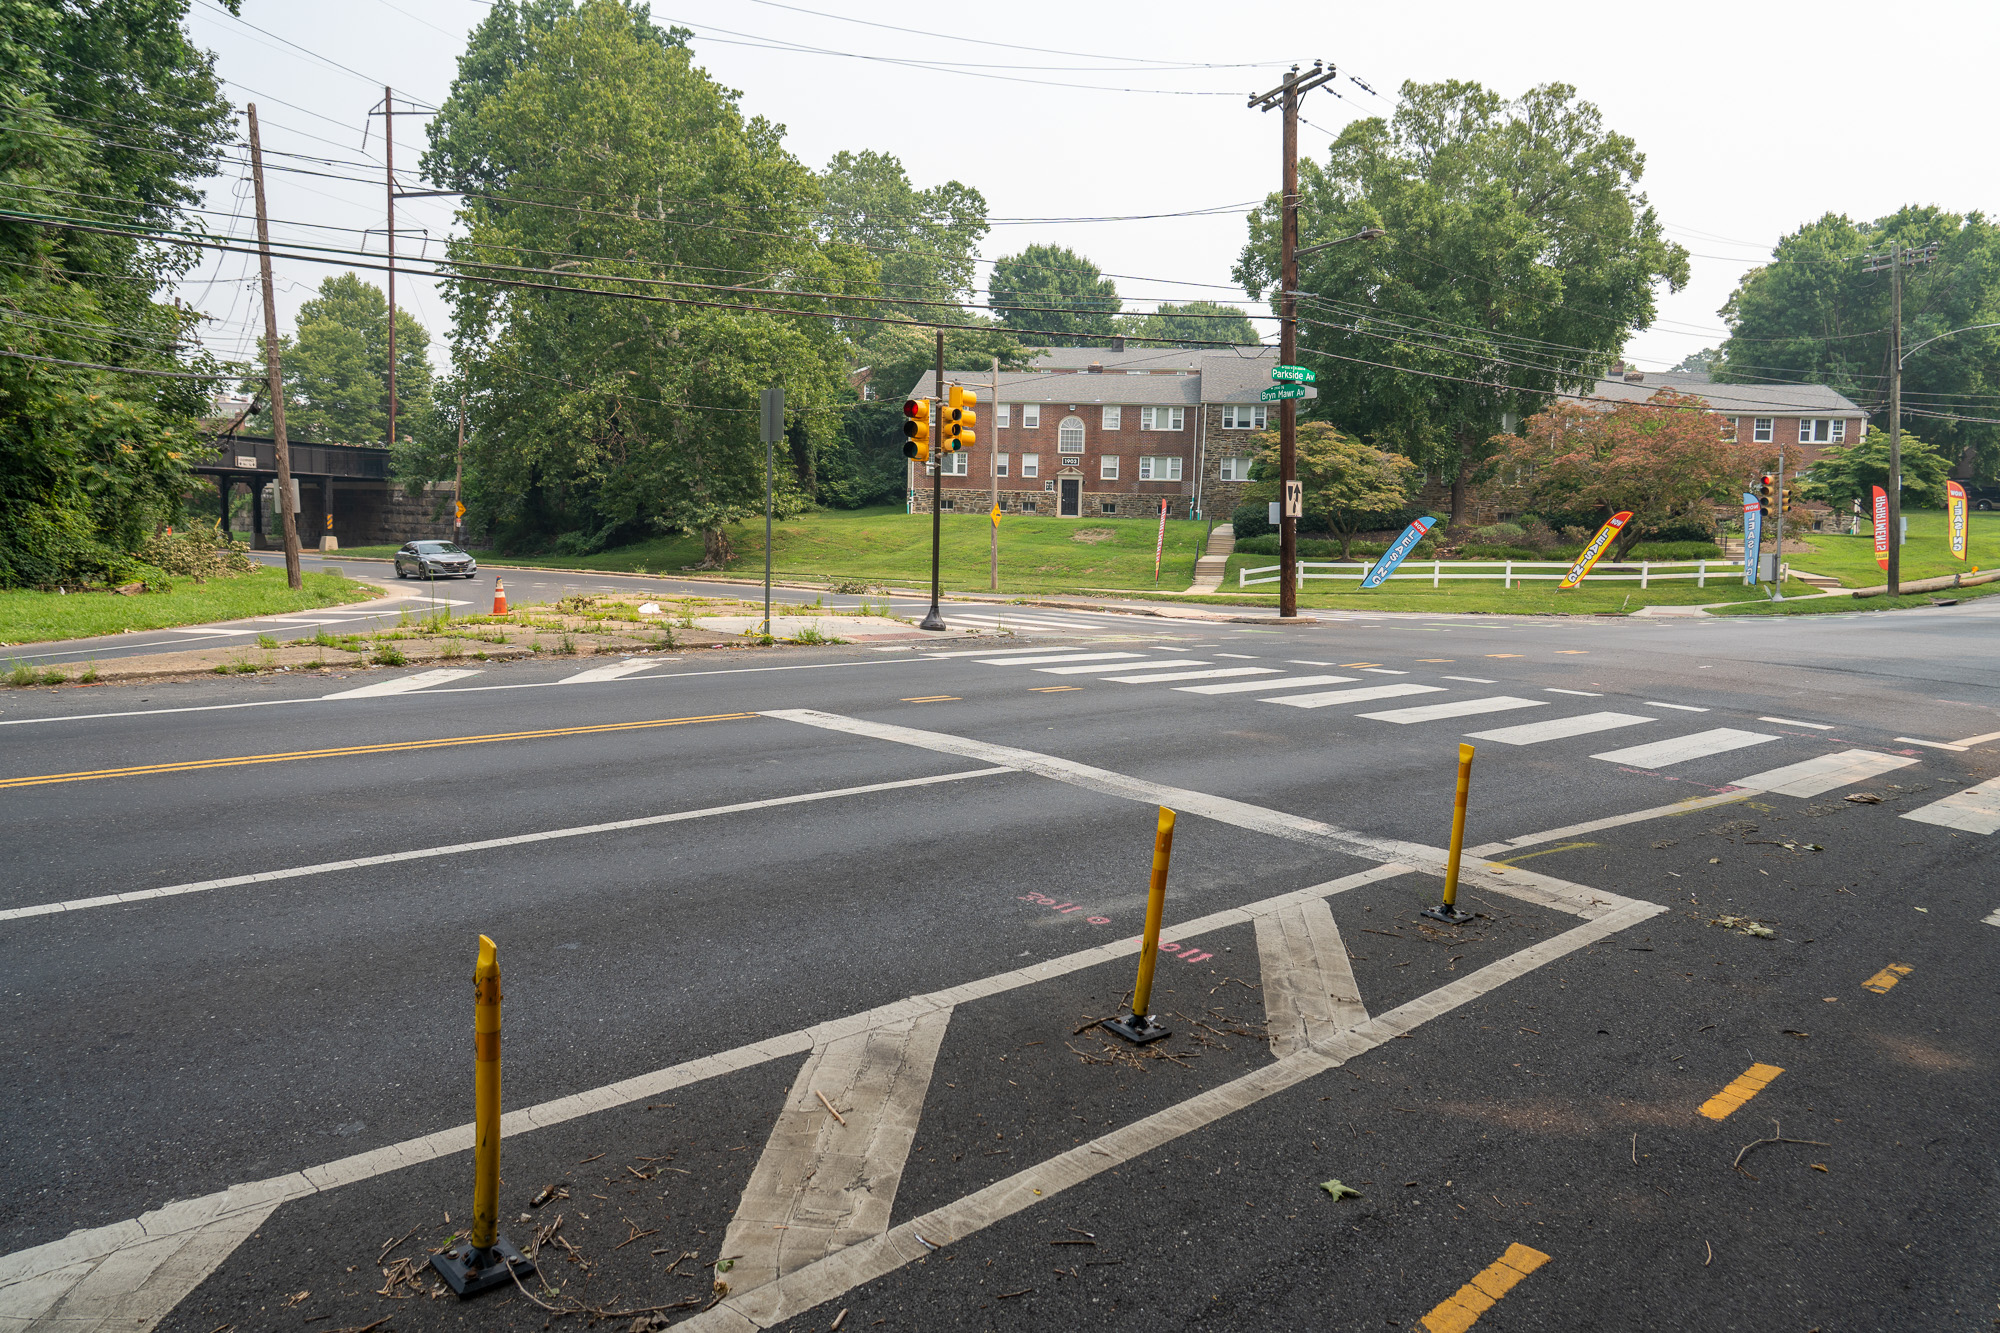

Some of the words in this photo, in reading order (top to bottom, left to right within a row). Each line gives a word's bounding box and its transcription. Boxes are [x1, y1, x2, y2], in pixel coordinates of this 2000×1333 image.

[1272, 369, 1303, 380] Parkside
[1306, 372, 1315, 380] Av
[1261, 391, 1276, 400] Bryn
[1278, 389, 1294, 399] Mawr
[1296, 388, 1305, 396] Av
[1413, 521, 1426, 533] NOW
[1372, 529, 1415, 585] LEASING
[1567, 527, 1610, 583] LEASING
